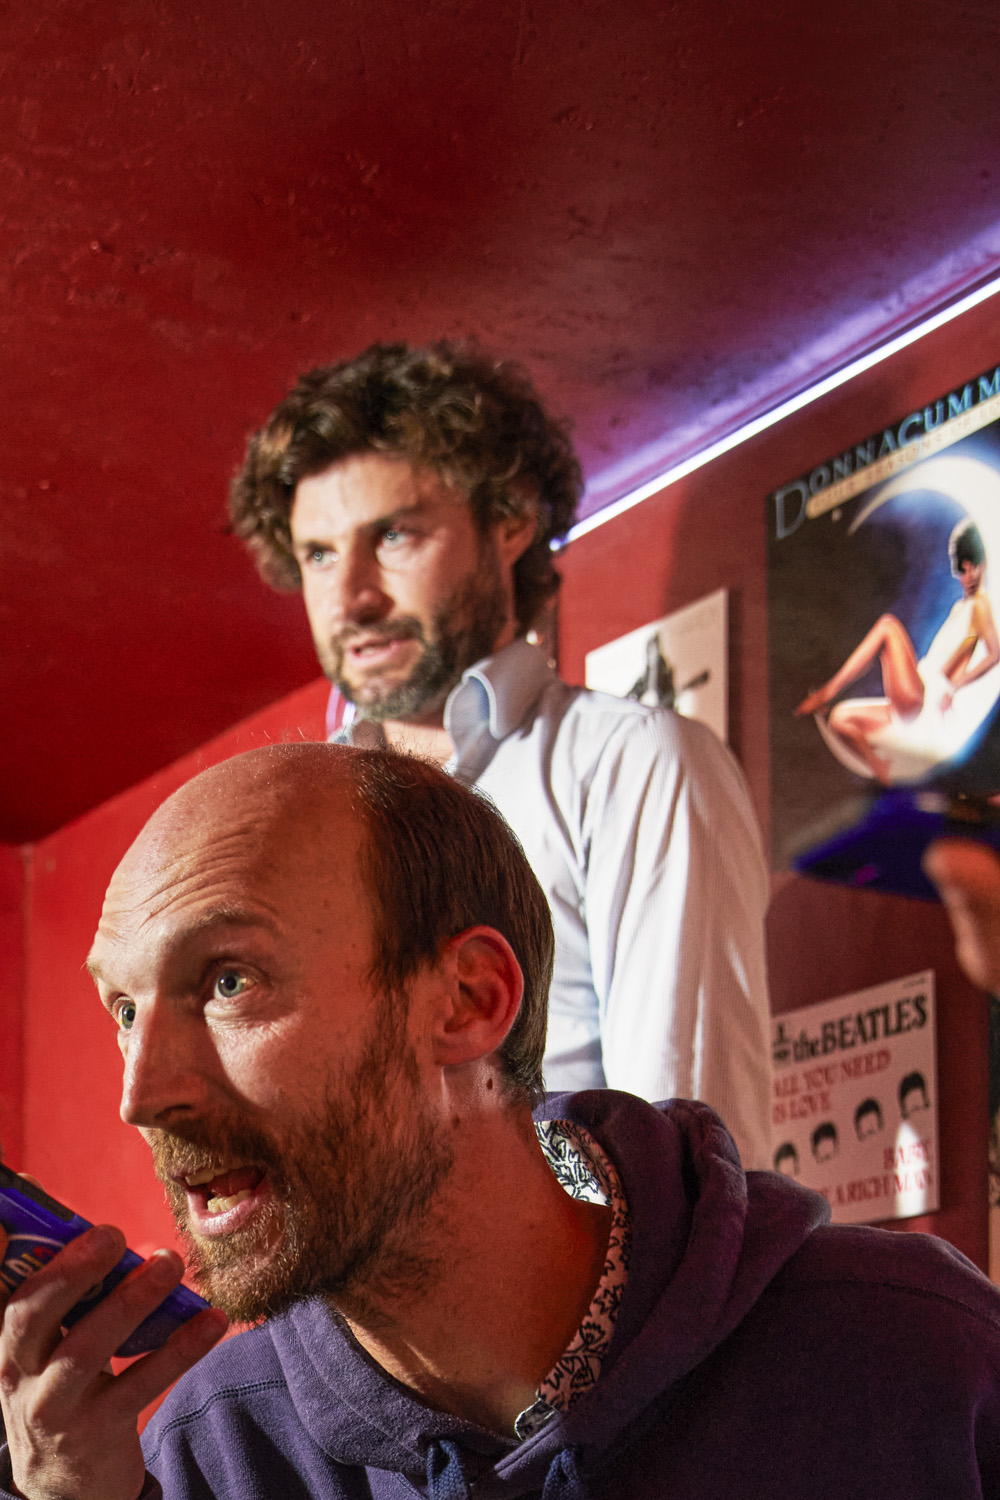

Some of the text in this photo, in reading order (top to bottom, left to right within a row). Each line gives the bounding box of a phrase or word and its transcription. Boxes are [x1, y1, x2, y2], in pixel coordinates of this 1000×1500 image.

[774, 426, 899, 541] DONNA
[793, 1028, 819, 1063] the
[821, 993, 928, 1056] BEATLES
[802, 1064, 836, 1091] YOU
[840, 1047, 892, 1082] NEED
[788, 1090, 832, 1121] LOVE
